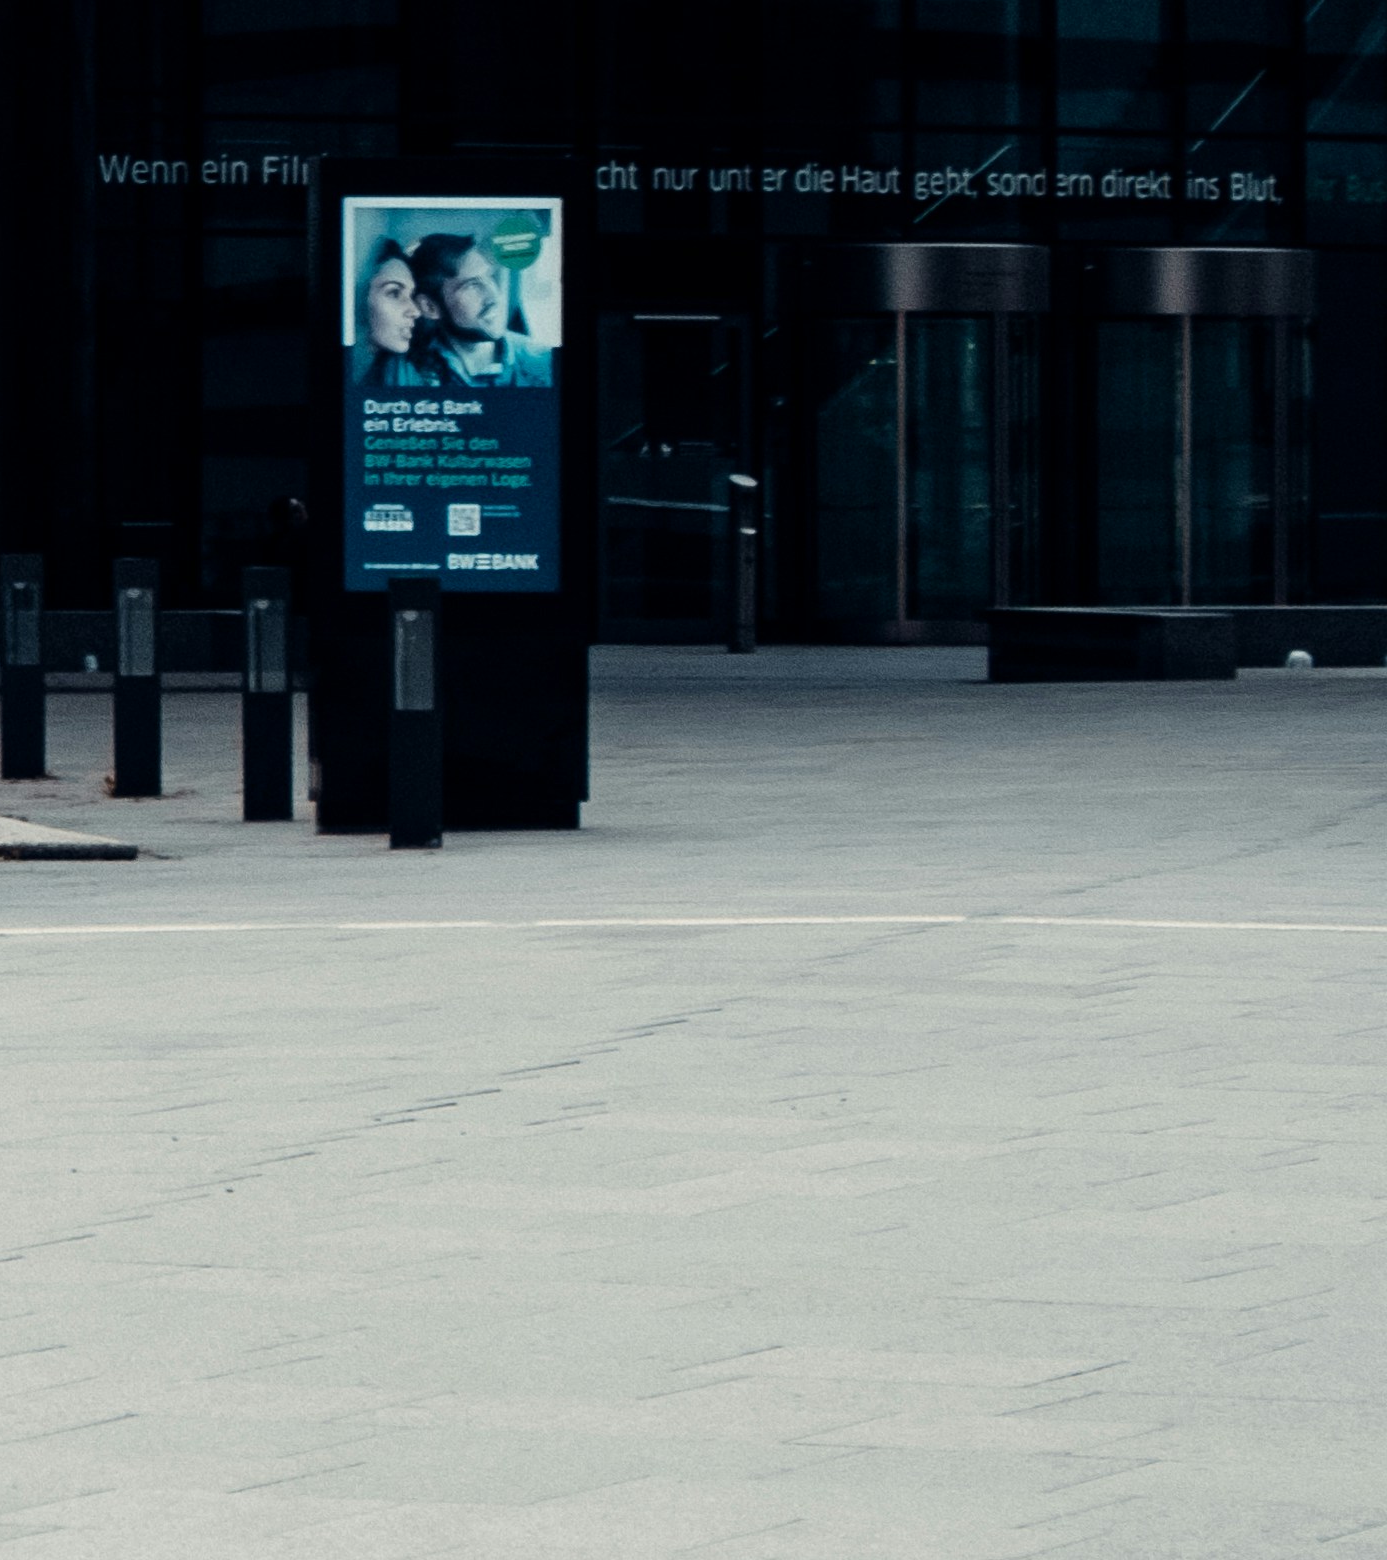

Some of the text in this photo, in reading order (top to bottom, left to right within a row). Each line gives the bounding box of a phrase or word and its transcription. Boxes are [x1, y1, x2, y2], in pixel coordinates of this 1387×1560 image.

[98, 153, 190, 185] Wenn
[201, 152, 250, 185] ein
[652, 166, 700, 192] nur
[709, 163, 788, 192] unter
[794, 161, 836, 193] die
[841, 164, 902, 195] Haut
[986, 167, 1093, 199] sondern
[1100, 168, 1173, 200] direkt
[1185, 169, 1221, 201] ins
[1229, 171, 1285, 204] Blut,
[363, 399, 483, 415] Durch die Bank
[363, 417, 461, 432] ein Erlebnis.
[364, 436, 499, 450] Genießen Sie den
[364, 454, 532, 469] BW-Bank Kulturwasen
[363, 472, 532, 489] in Ihrer eigenen Loge.
